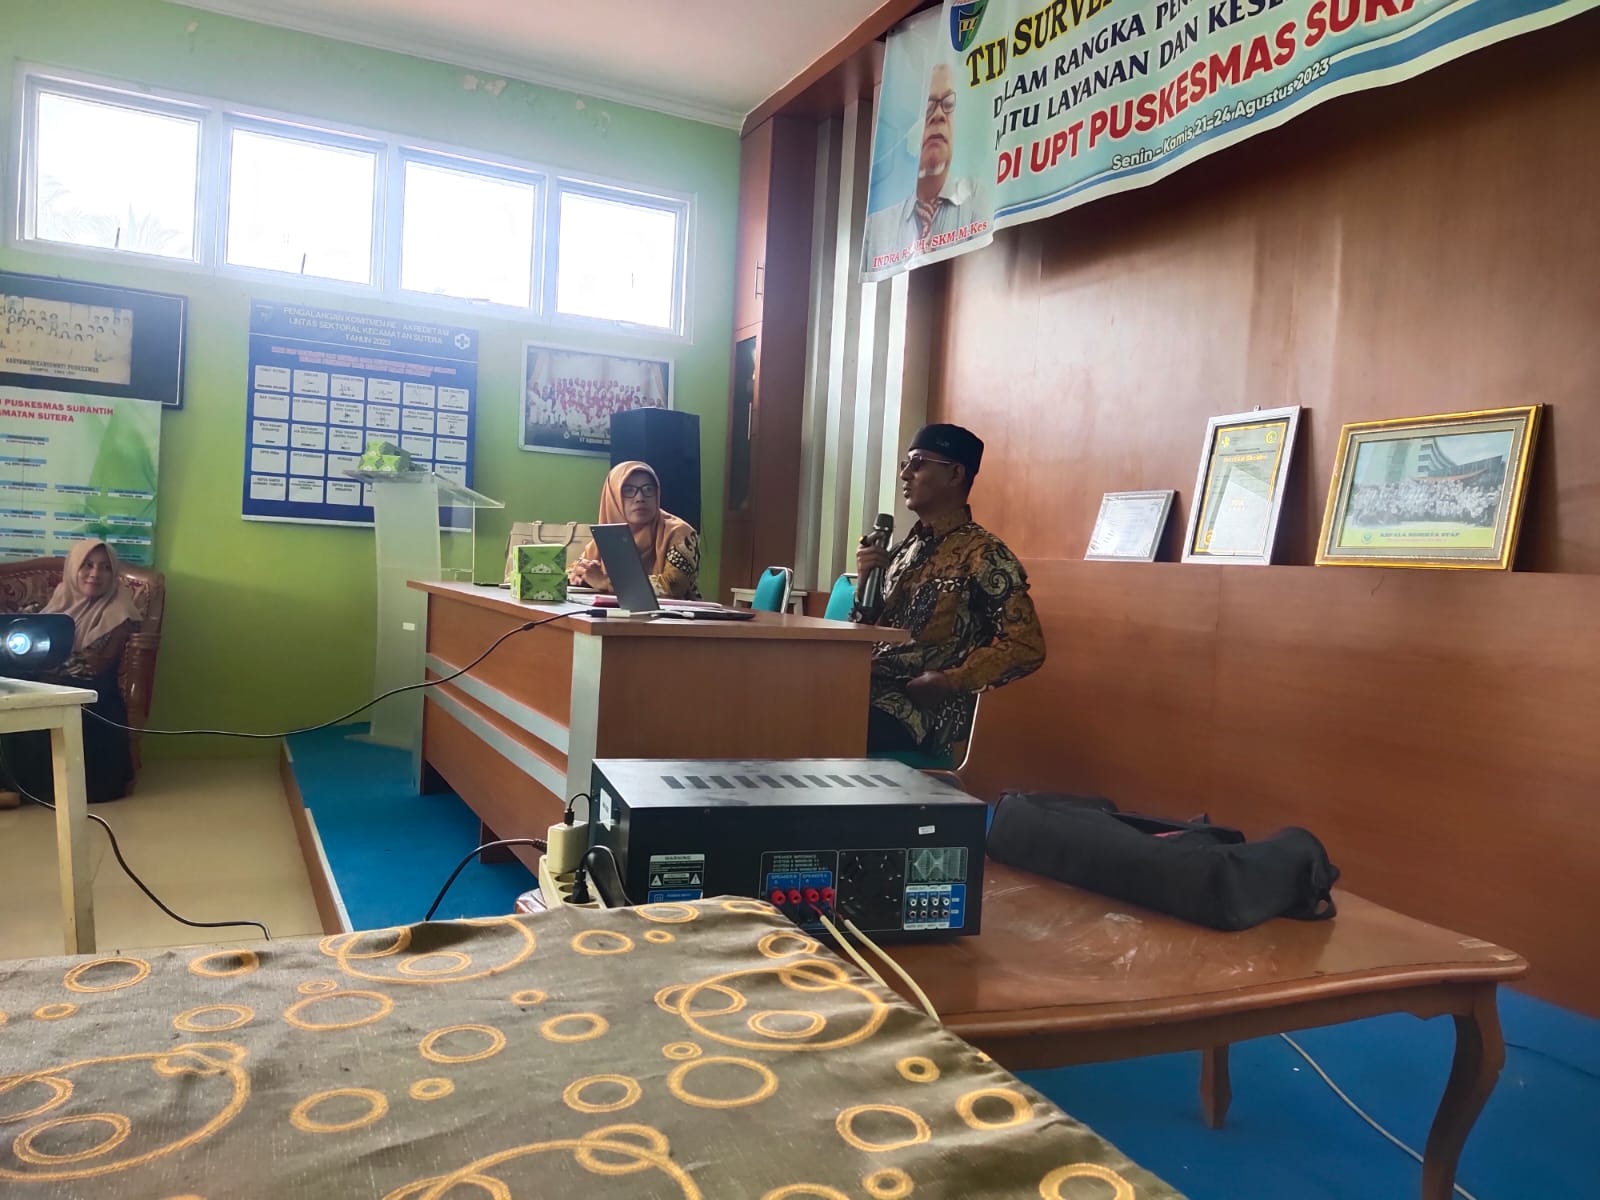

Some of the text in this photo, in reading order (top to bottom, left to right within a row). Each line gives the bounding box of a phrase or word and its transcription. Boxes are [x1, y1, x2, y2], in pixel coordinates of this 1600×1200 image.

[993, 65, 1048, 119] DLAM
[1054, 14, 1146, 80] RANGKA
[1013, 0, 1112, 58] SURV
[1047, 50, 1149, 120] LAYANAN
[1160, 15, 1198, 69] DAN
[996, 0, 1415, 185] DI UPT PUSKESMAS SUR
[1112, 146, 1154, 171] Senin
[1295, 56, 1330, 91] 2023
[873, 251, 900, 268] INDRA
[5, 398, 114, 416] PUSKESMAS SURANTIH
[37, 413, 75, 423] SUTERA
